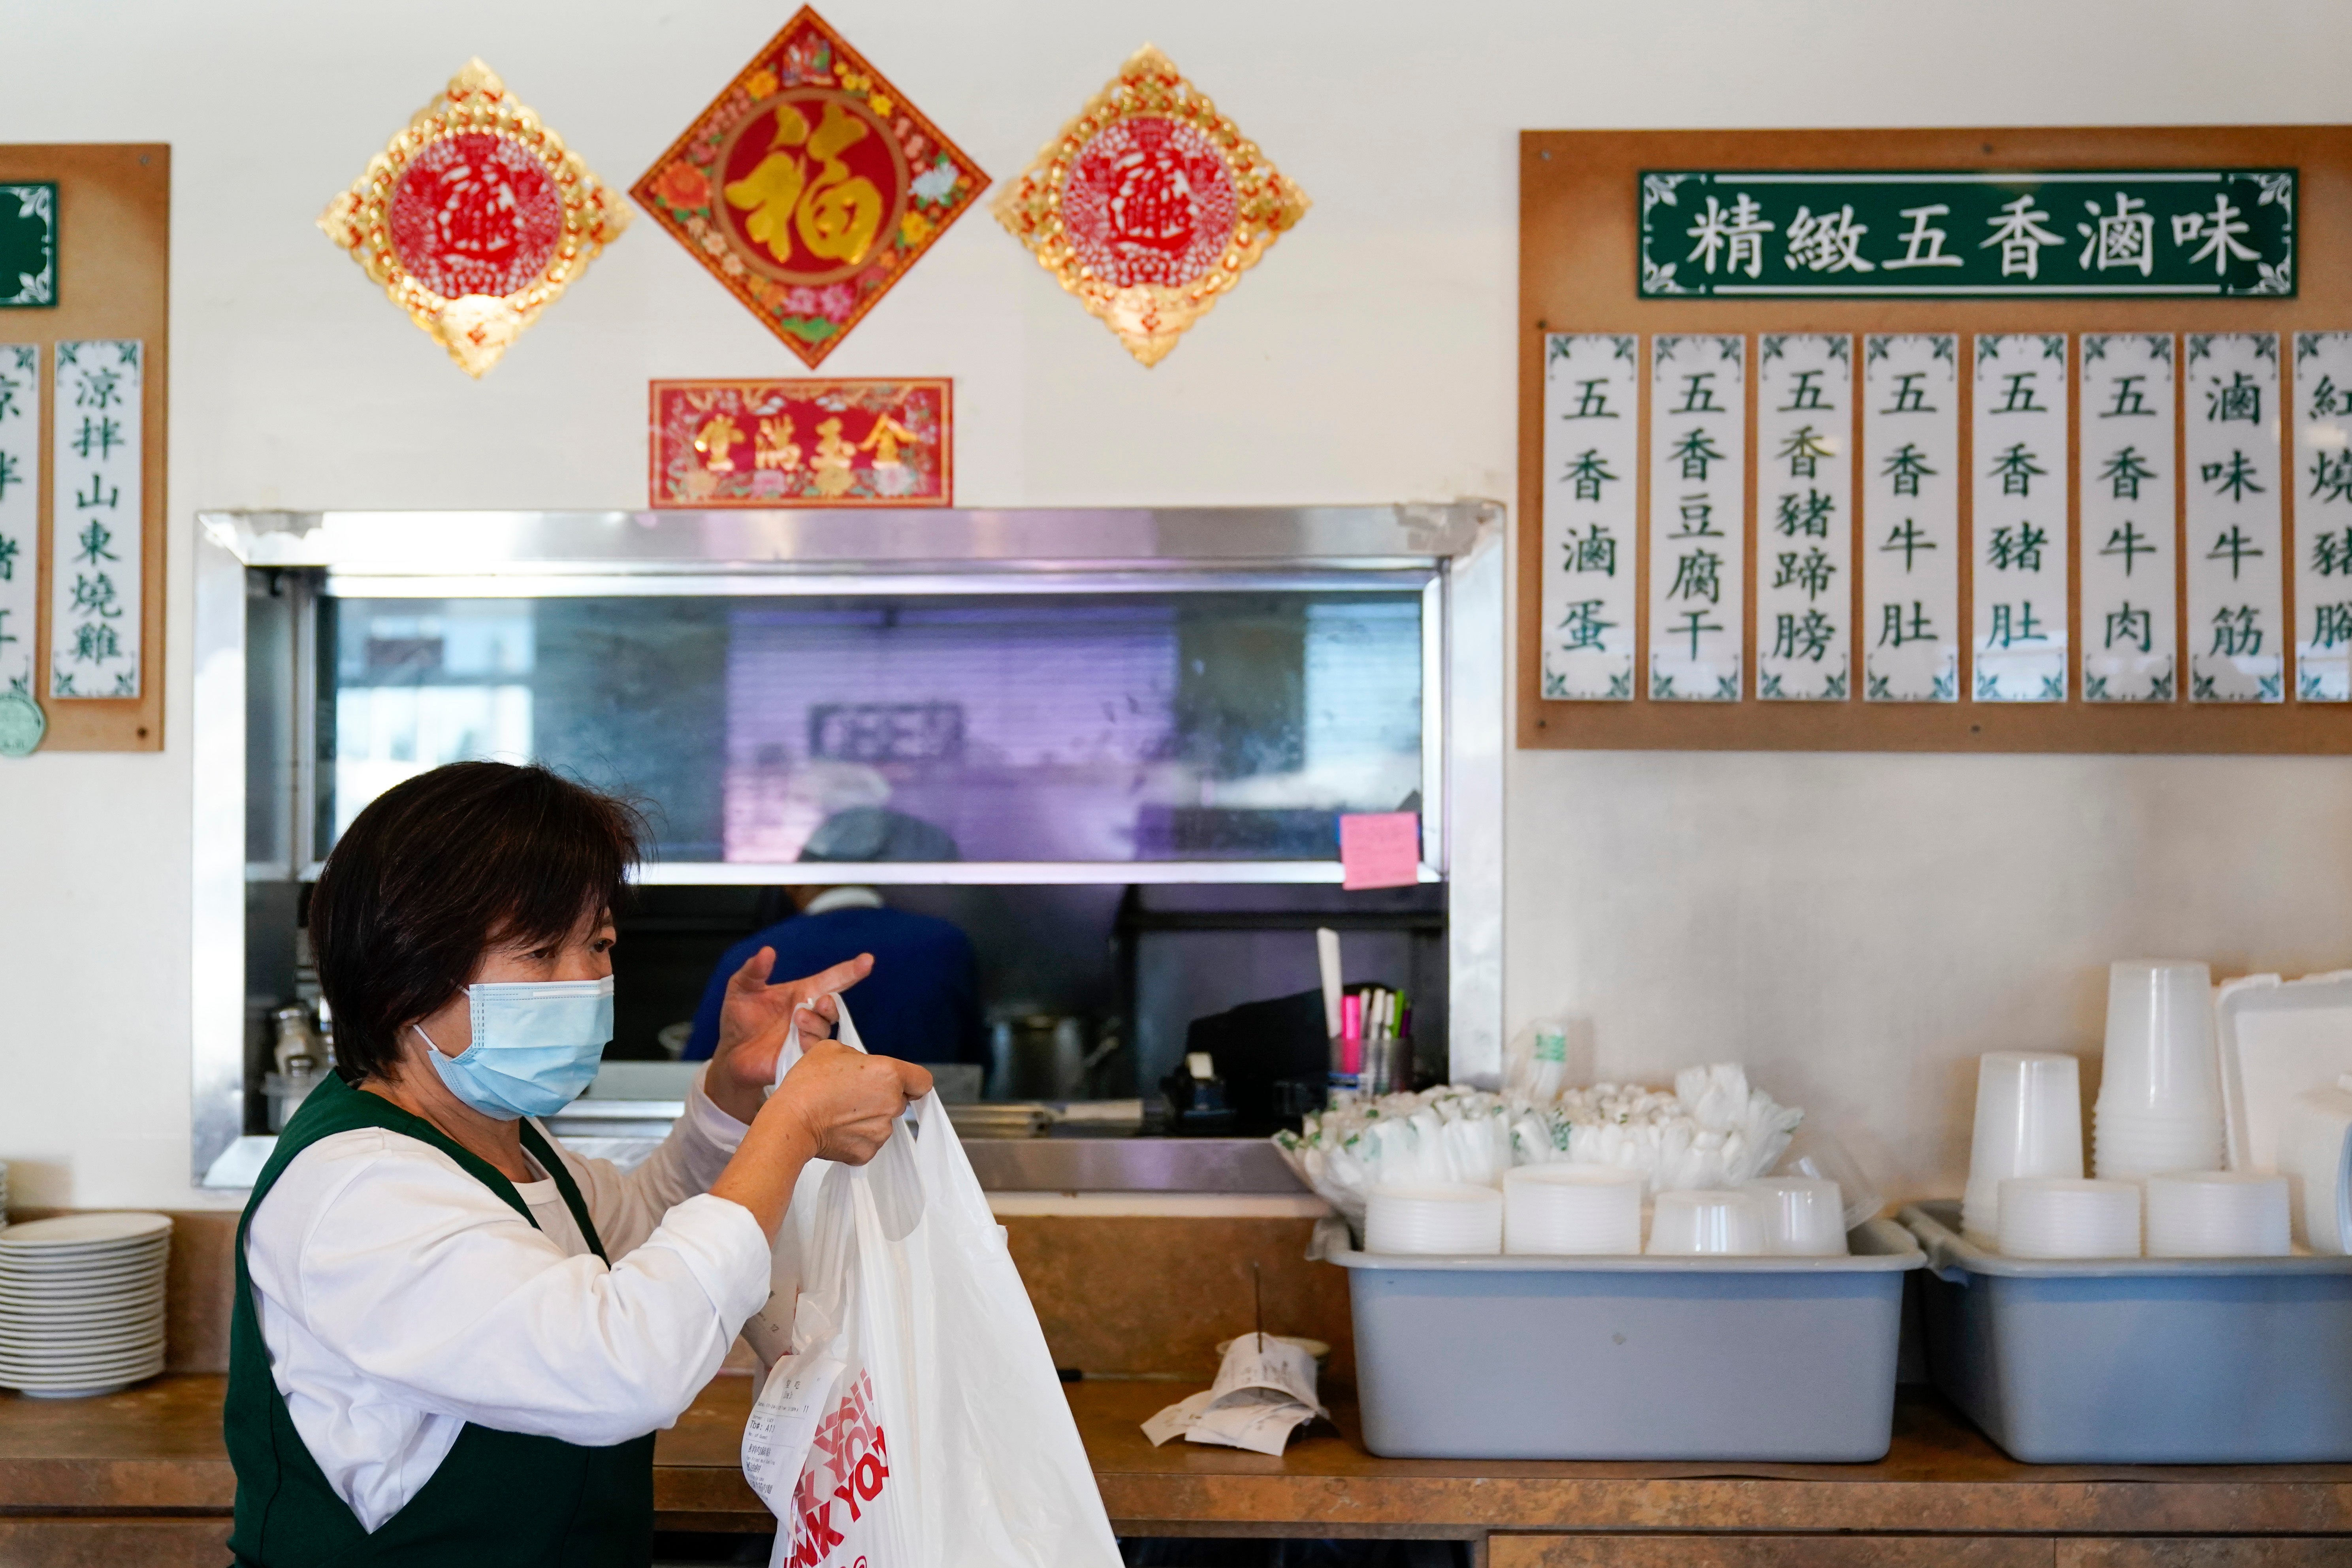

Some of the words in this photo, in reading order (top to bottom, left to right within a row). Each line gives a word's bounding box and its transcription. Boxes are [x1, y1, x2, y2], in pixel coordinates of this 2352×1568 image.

[724, 102, 883, 265] 福
[1686, 192, 2262, 279] 精緻五香滷味
[1560, 378, 1619, 651] 五香滷蛋
[1667, 373, 1726, 661] 五香豆腐干
[1772, 369, 1836, 662] 五香豬蹄膀
[1878, 373, 1938, 648] 五香牛肚
[1987, 372, 2049, 648] 五香豬肚
[2098, 375, 2157, 652] 五香牛肉
[2200, 371, 2265, 657] 滷味牛筋
